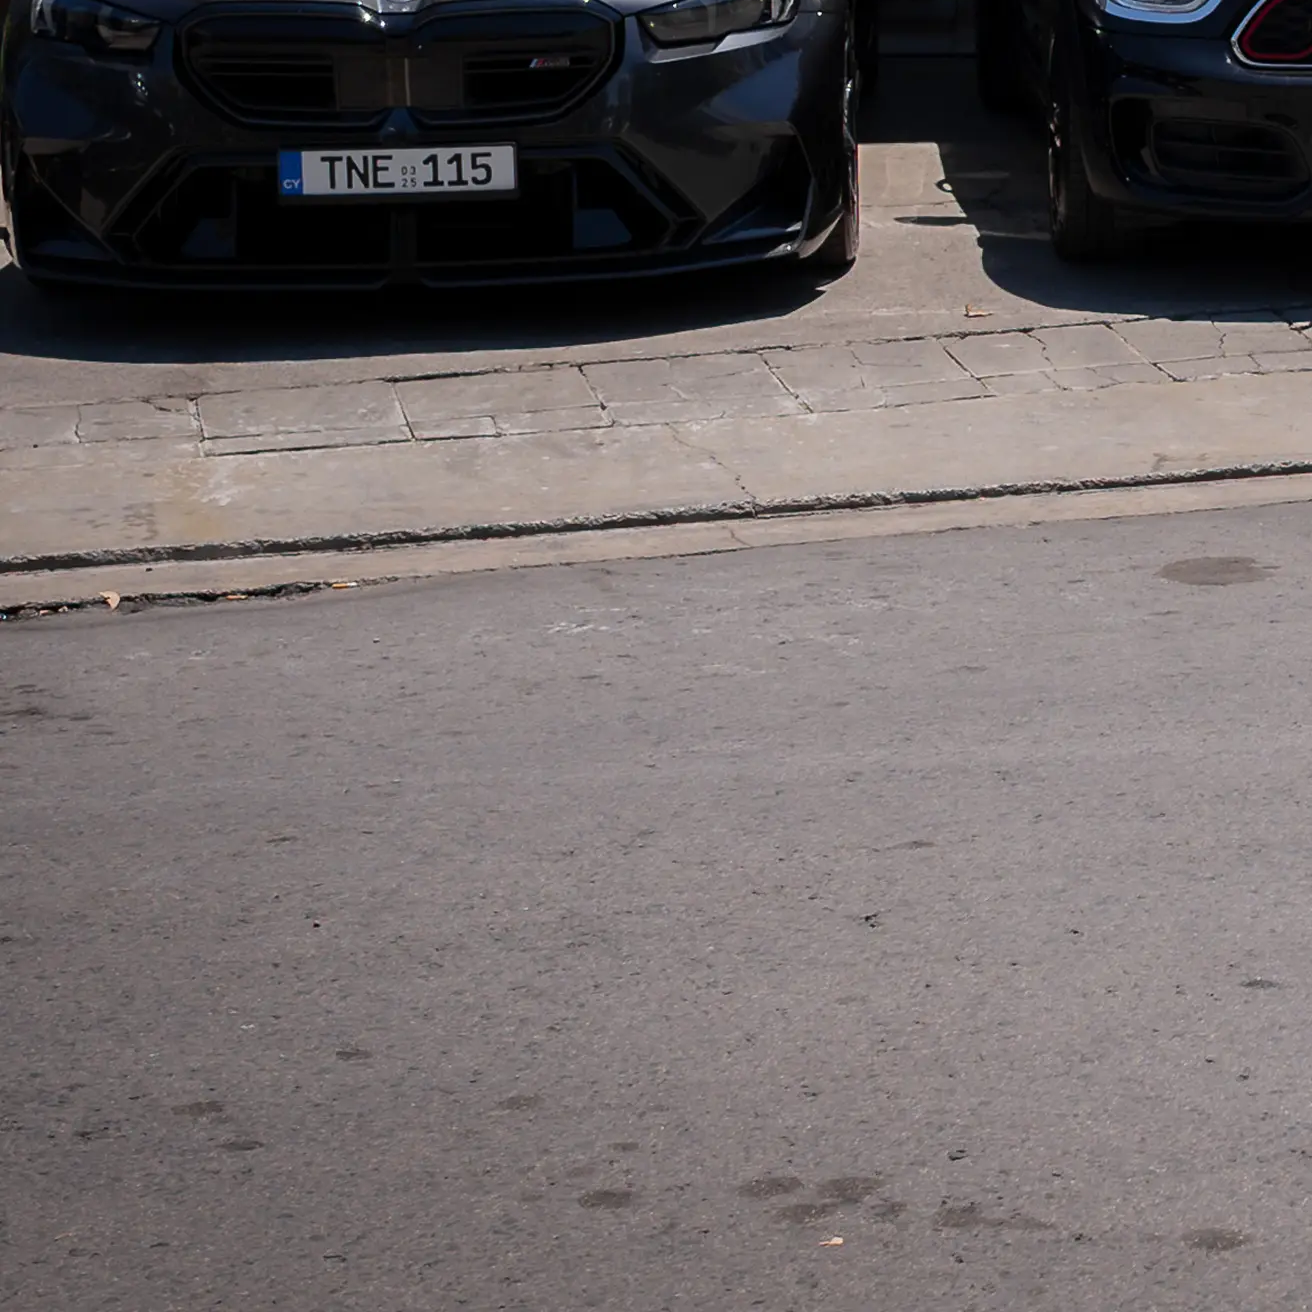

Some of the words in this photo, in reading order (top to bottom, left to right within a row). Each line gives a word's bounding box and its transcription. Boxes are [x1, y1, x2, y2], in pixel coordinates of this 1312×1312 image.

[320, 154, 396, 190] TNE
[421, 152, 493, 188] 115
[283, 178, 301, 190] CY
